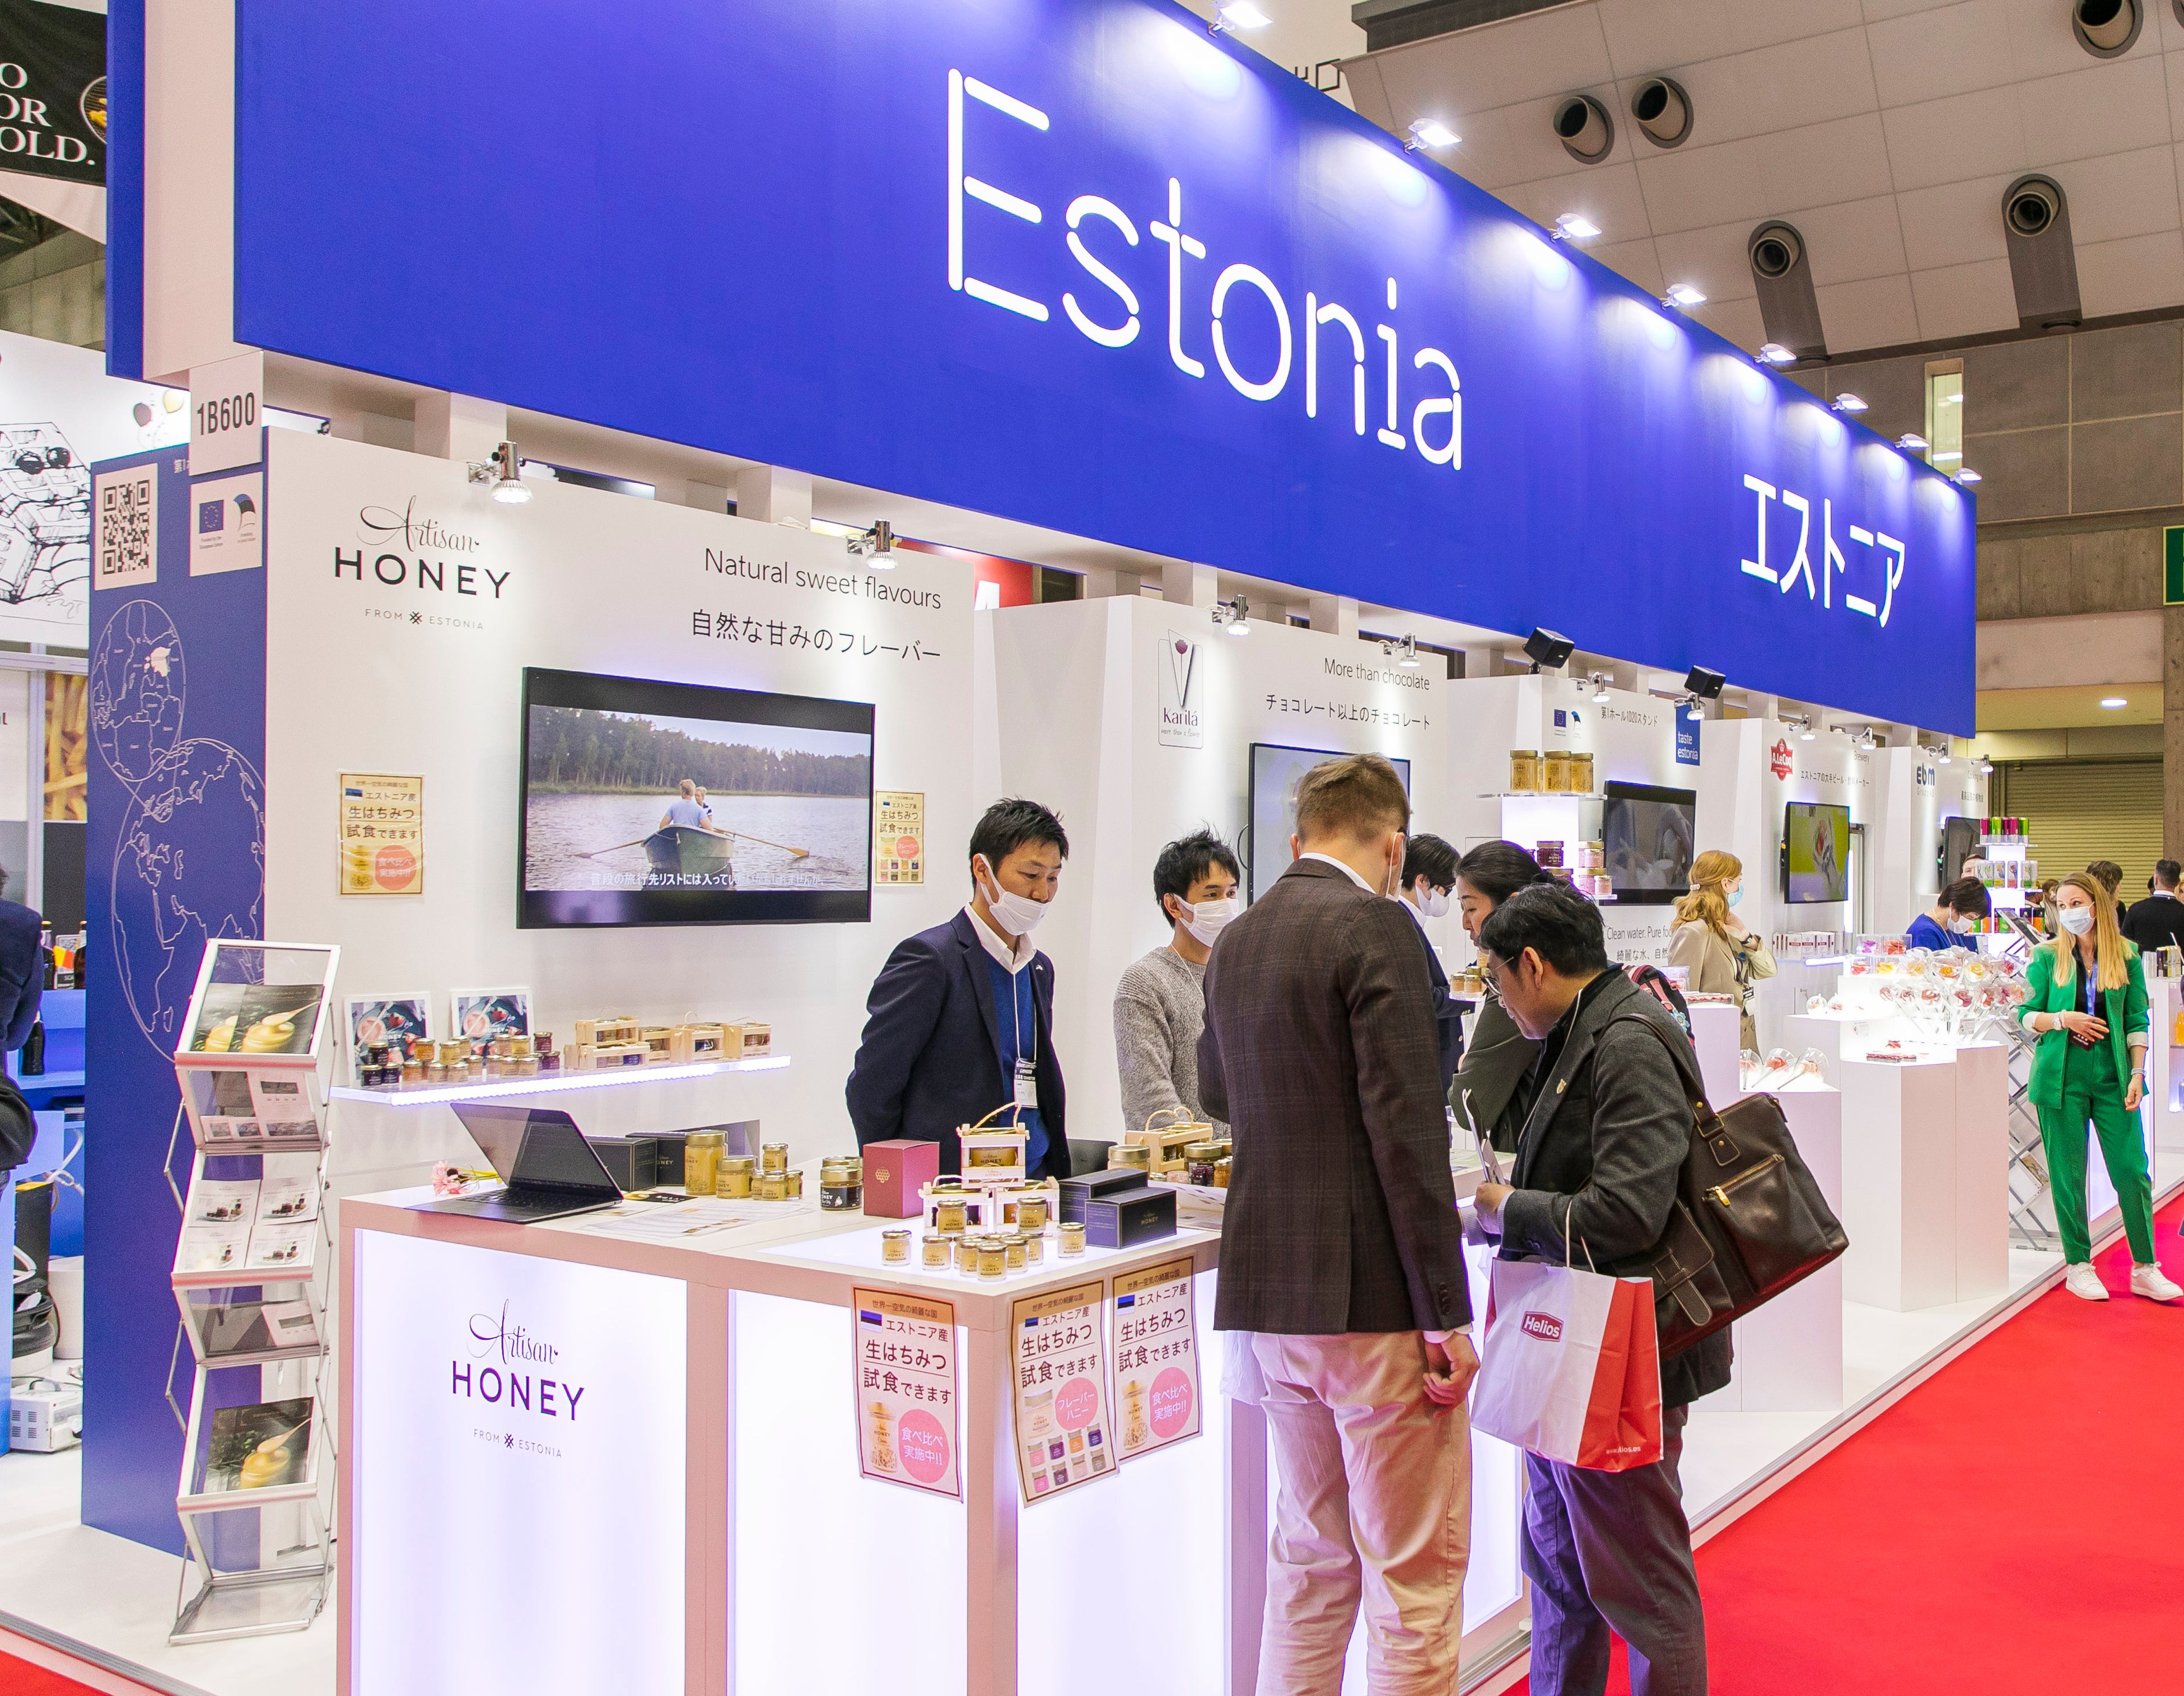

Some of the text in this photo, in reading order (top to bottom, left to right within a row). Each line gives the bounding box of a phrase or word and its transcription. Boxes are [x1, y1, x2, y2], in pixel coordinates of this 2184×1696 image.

[948, 68, 1462, 470] Estonia
[197, 391, 255, 436] 1B600
[356, 495, 479, 553] Artisan
[1740, 474, 1905, 628] エストニア
[334, 546, 511, 599] HONEY
[705, 548, 942, 609] Natural sweet flavours
[365, 608, 484, 630] FROM ESTONIA
[692, 608, 941, 661] 自然な甘みのフレーバー
[1324, 657, 1430, 690] More than chocolate
[1266, 694, 1430, 730] チョコレート以上のチョコレート
[1678, 731, 1692, 745] taste
[1677, 746, 1698, 760] estonia
[348, 806, 414, 820] 生はちみつ
[881, 810, 918, 820] 生はちみつ
[346, 824, 418, 839] 試食できます
[879, 823, 920, 835] 試食できます
[1607, 927, 1625, 940] Clean
[1627, 927, 1646, 939] water.
[1648, 926, 1662, 938] Pure
[1141, 1217, 1159, 1225] HONEY
[1137, 1283, 1188, 1307] エストニア産
[872, 1300, 937, 1319] 世界一空気の綺麗な国
[1043, 1306, 1090, 1327] エストニア産
[466, 1298, 558, 1365] Artisan
[886, 1319, 949, 1342] エストニア産
[1121, 1307, 1186, 1342] 生はちみつ
[1524, 1316, 1560, 1338] Helios
[866, 1339, 946, 1370] 生はちみつ
[1021, 1324, 1092, 1358] 生はちみつ
[1119, 1337, 1191, 1373] 試食できます
[1021, 1353, 1098, 1389] 試食できます
[452, 1360, 585, 1421] HONEY
[864, 1367, 951, 1404] 試食できます
[1152, 1383, 1188, 1405] 食べ比べ
[1058, 1391, 1095, 1410] フレーバー
[1066, 1408, 1089, 1421] ハニー
[474, 1428, 562, 1458] FROM ESTONIA
[902, 1427, 943, 1447] 食べ比べ
